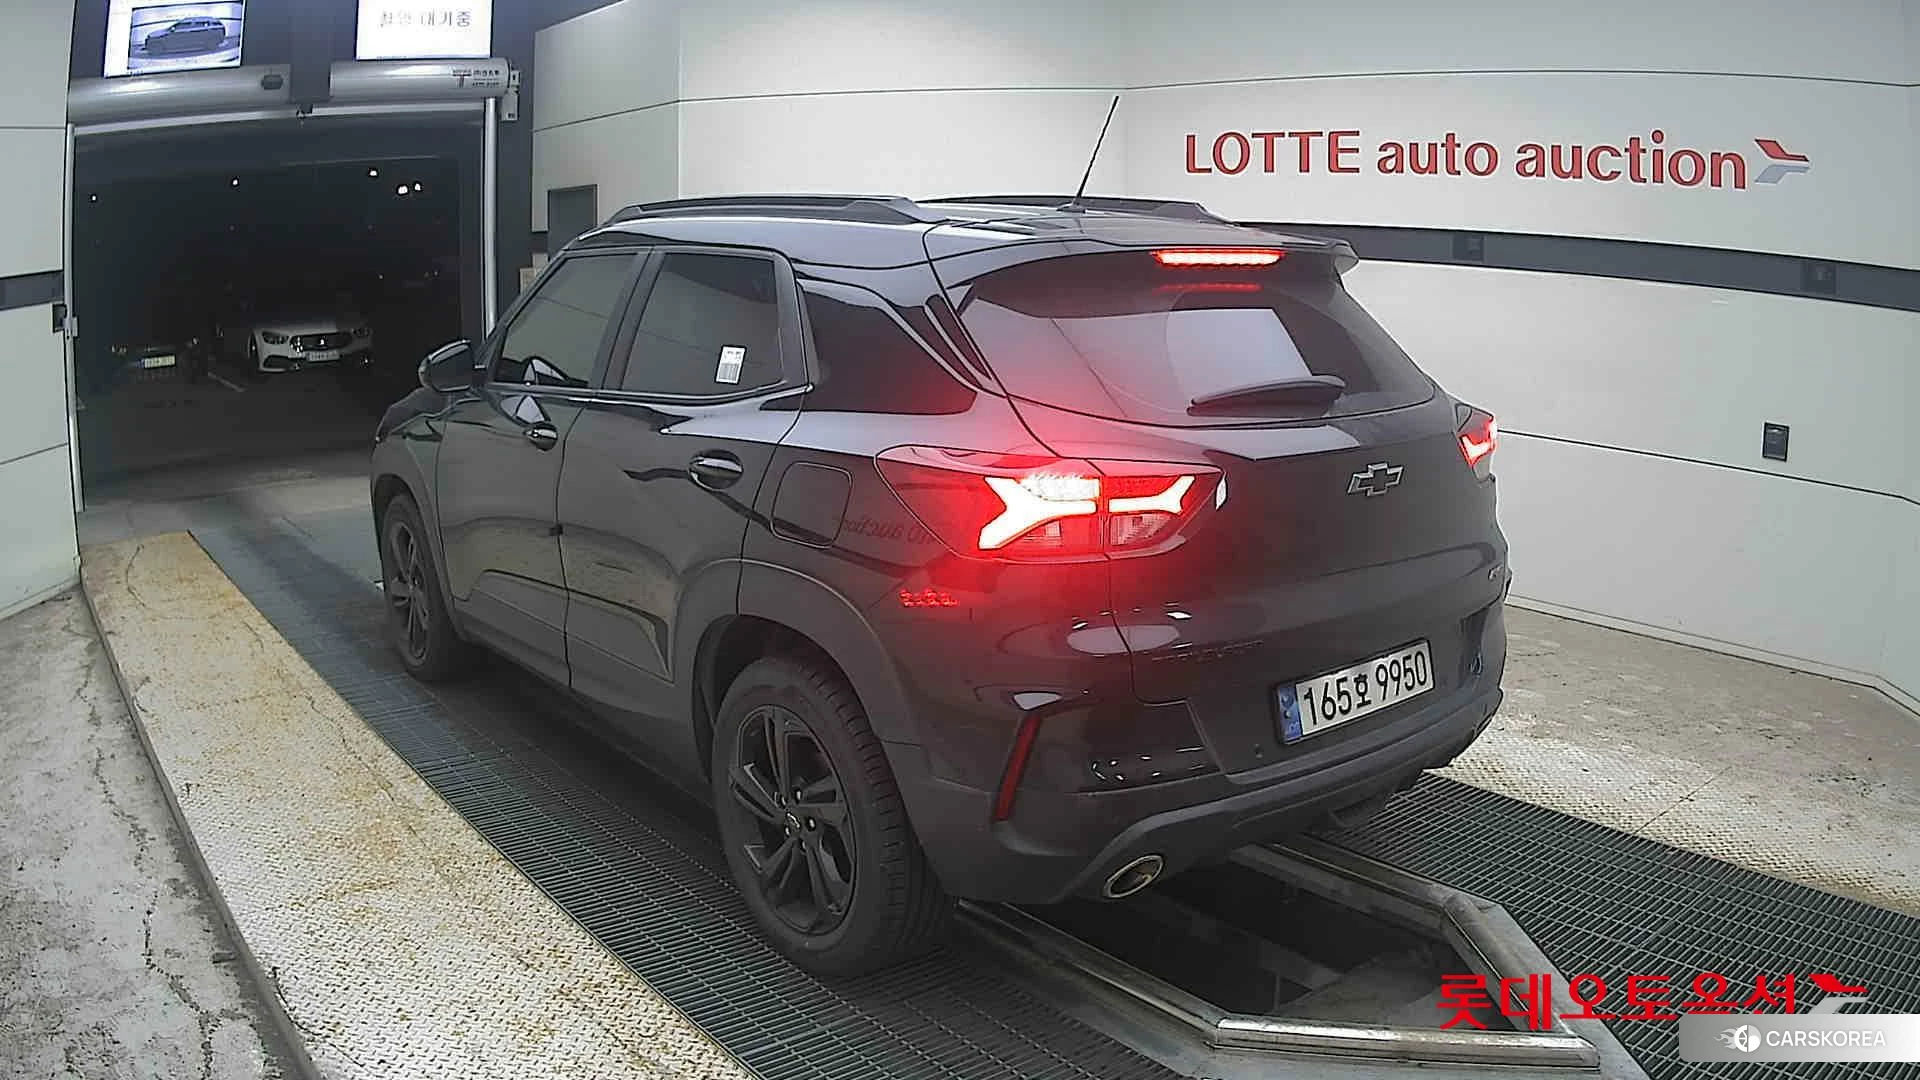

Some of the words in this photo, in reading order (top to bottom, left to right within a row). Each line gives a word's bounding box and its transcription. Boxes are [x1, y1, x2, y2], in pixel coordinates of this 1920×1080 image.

[1186, 130, 1360, 174] LOTTE
[1378, 132, 1498, 176] auto
[1516, 130, 1747, 189] auction
[1303, 673, 1372, 726] 165호
[1375, 650, 1428, 701] 9950
